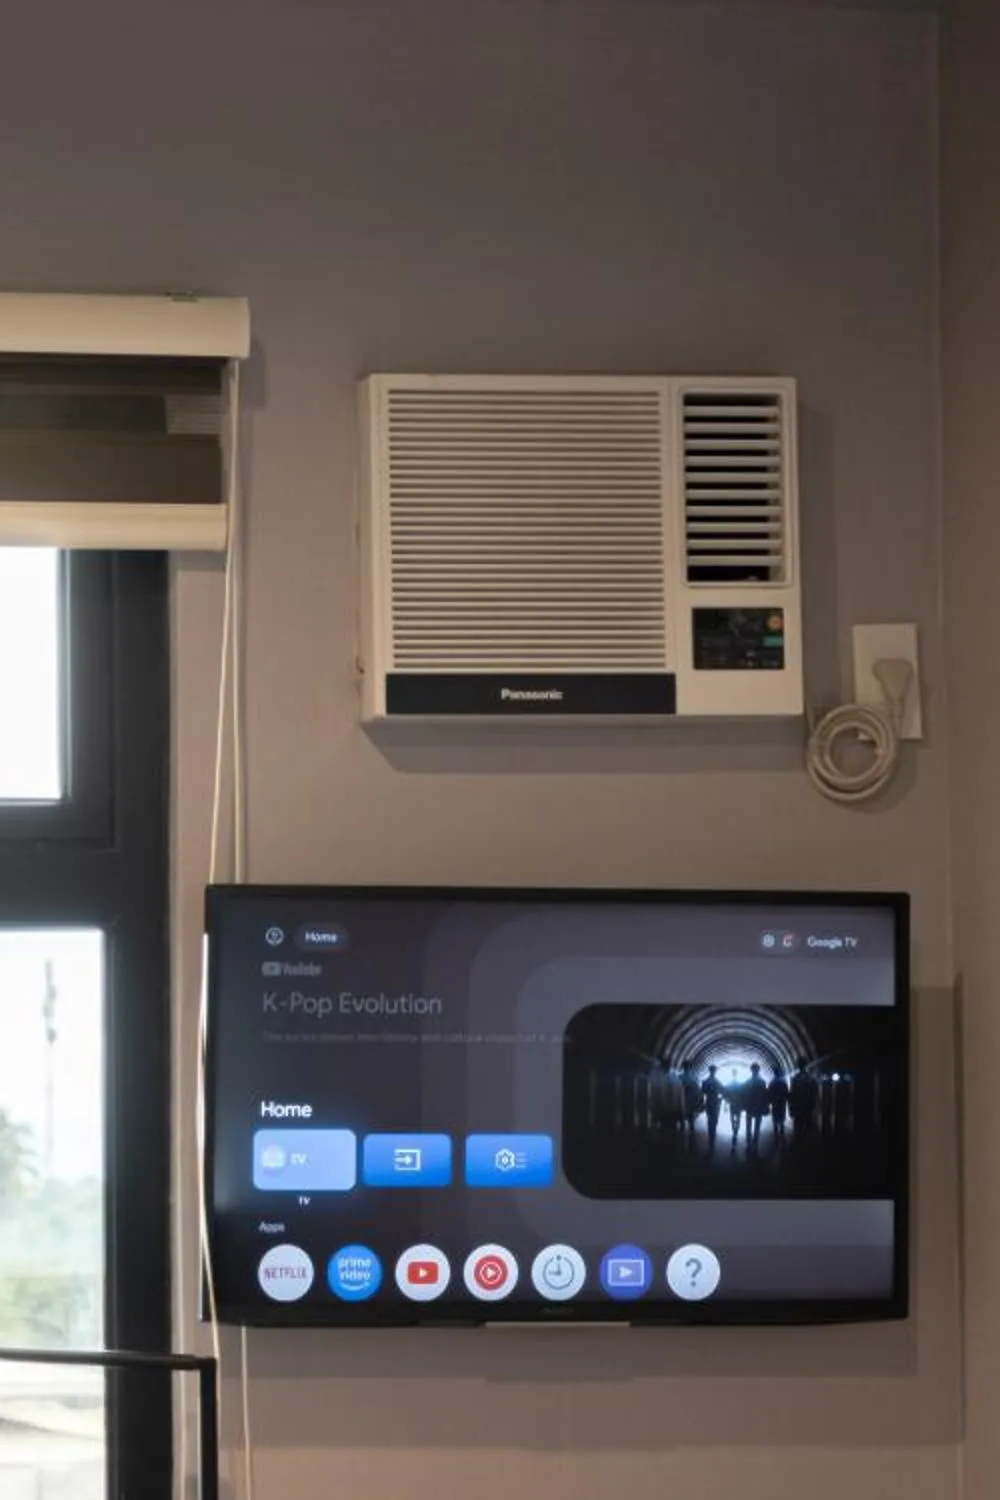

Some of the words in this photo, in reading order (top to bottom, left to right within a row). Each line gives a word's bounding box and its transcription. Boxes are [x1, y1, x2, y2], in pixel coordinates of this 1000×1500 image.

[501, 688, 563, 701] Panasonic
[304, 931, 338, 944] Home
[807, 936, 842, 949] Google
[844, 936, 858, 948] TV
[261, 993, 333, 1018] K-Pop
[339, 992, 443, 1016] Evolution
[260, 1101, 312, 1118] Home
[258, 1220, 286, 1234] Apps
[338, 1257, 372, 1272] prime
[263, 1267, 308, 1280] NETFLIX
[338, 1268, 372, 1281] video
